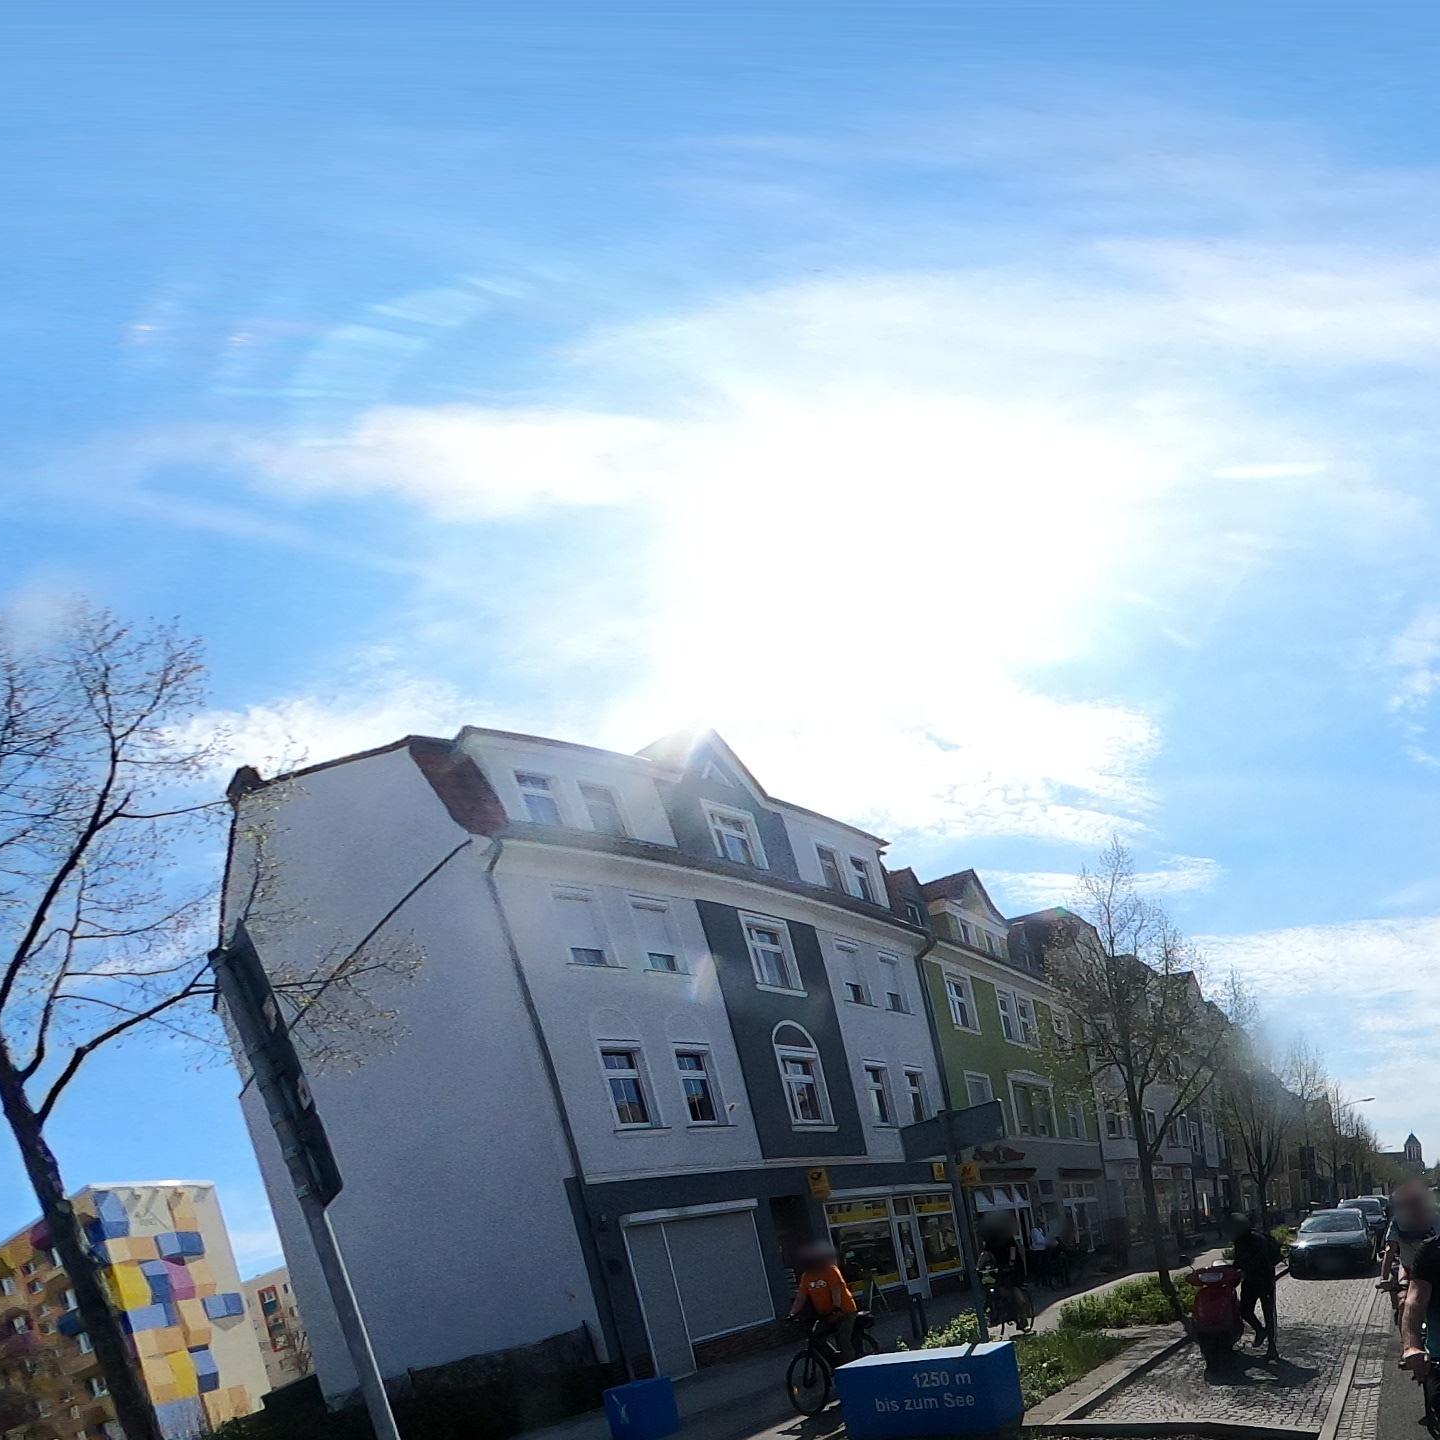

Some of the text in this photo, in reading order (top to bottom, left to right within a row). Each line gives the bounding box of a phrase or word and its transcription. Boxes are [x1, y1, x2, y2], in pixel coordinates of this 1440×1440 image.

[912, 1371, 972, 1389] 1250 m
[875, 1392, 975, 1413] bis zum See
